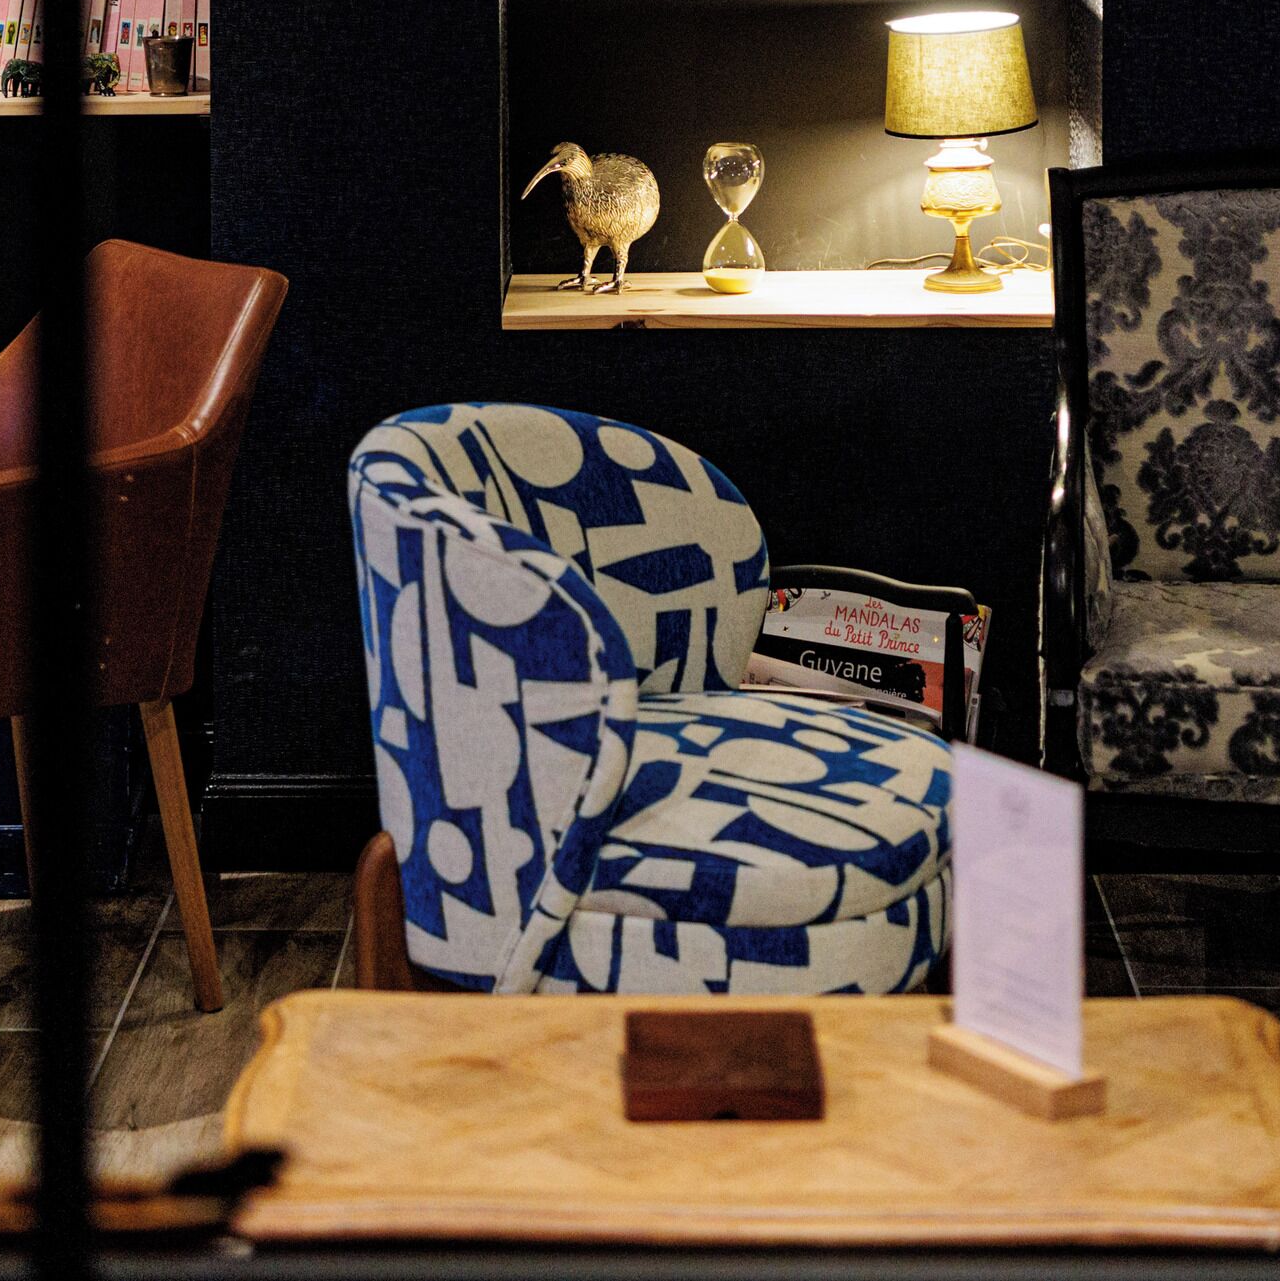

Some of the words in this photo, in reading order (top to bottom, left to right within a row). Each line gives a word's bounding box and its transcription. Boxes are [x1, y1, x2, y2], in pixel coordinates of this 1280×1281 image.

[865, 596, 884, 610] Les
[835, 605, 921, 633] MANDALAS
[824, 620, 841, 637] du
[844, 624, 873, 646] Petit
[877, 630, 920, 654] Prince
[800, 650, 882, 683] Guyane
